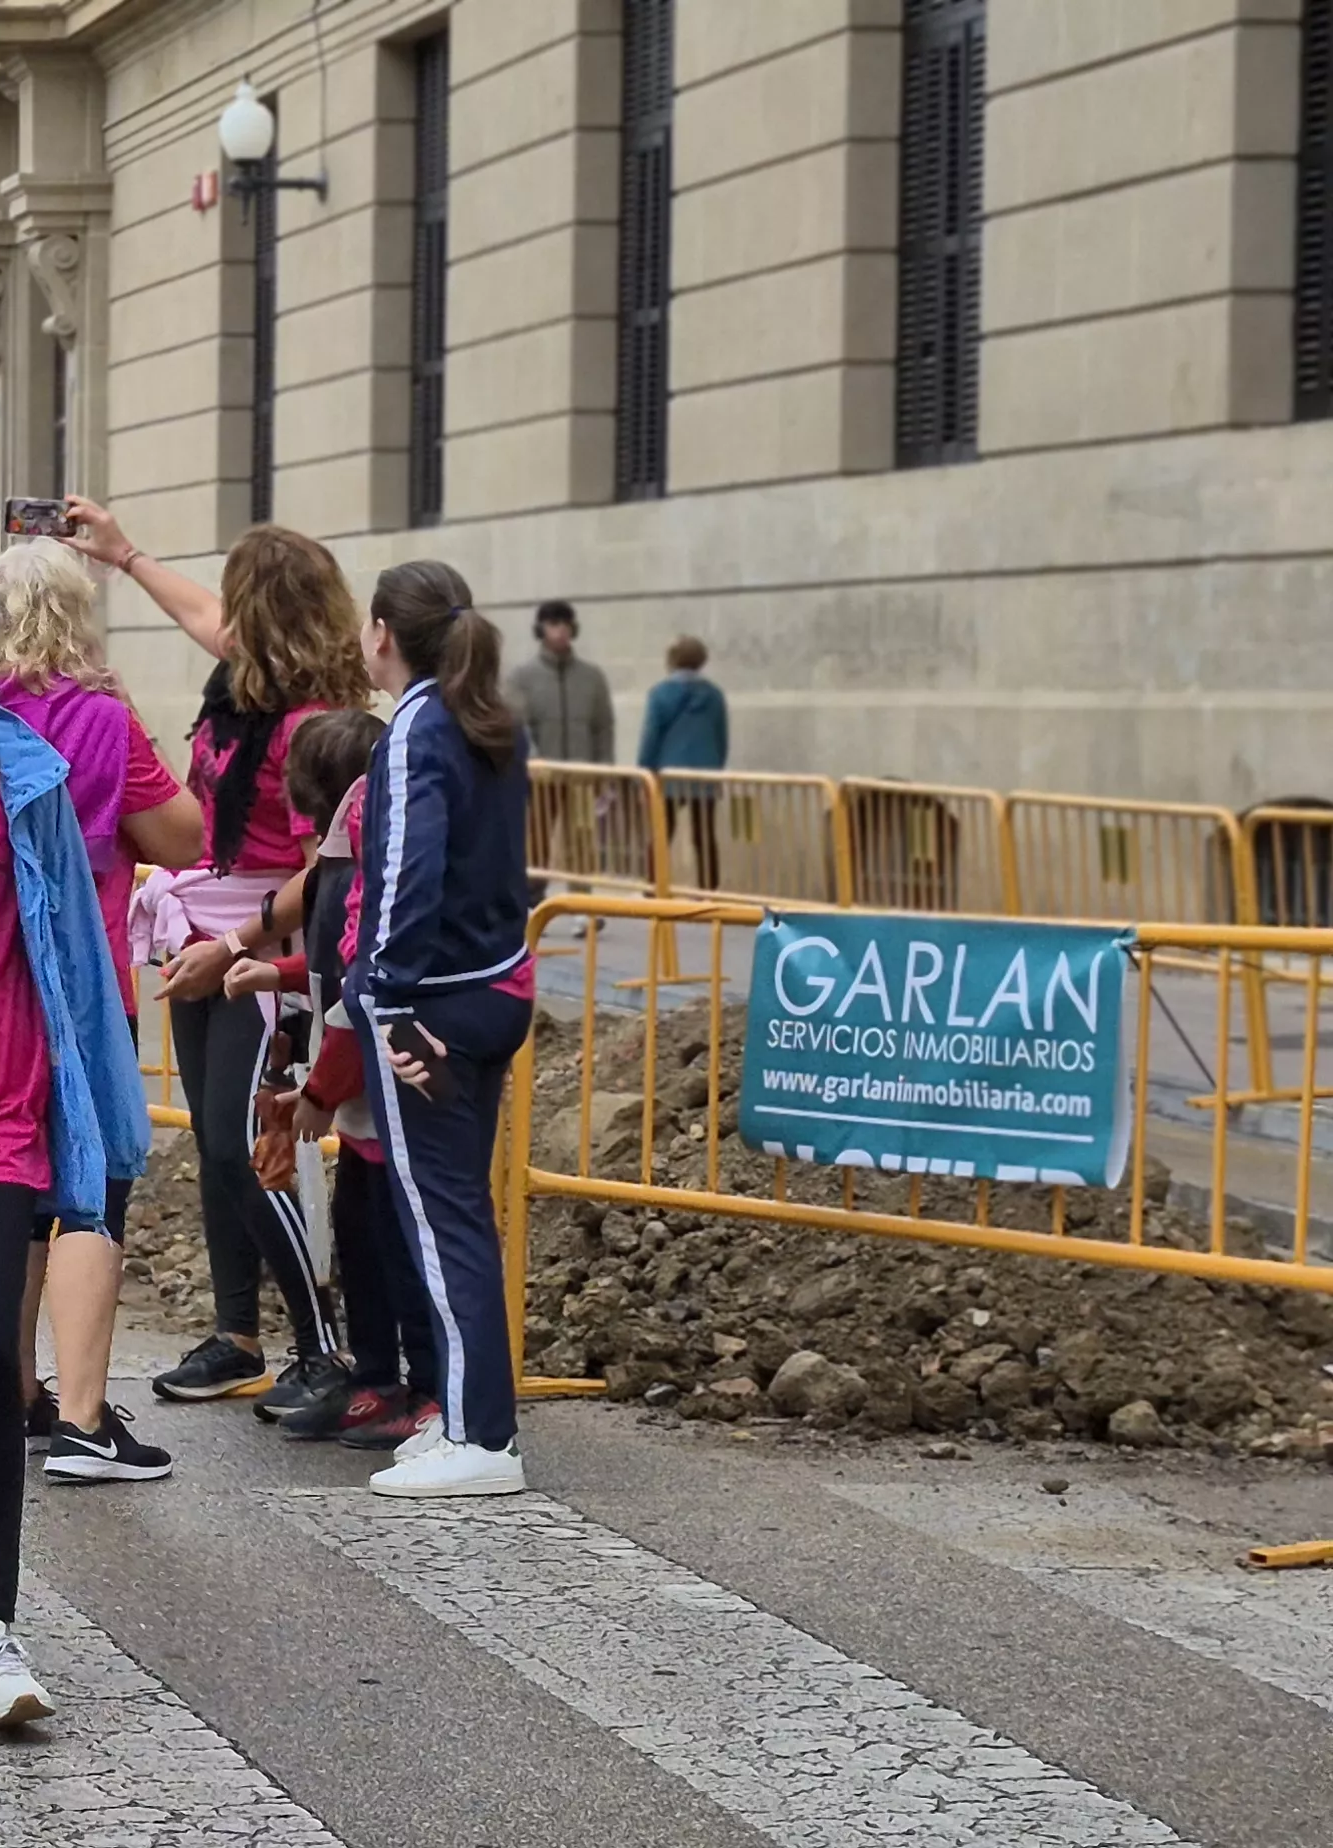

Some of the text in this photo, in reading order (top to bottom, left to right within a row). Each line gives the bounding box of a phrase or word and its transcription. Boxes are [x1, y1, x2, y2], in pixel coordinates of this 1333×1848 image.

[774, 936, 1103, 1034] GARLAN
[766, 1018, 1095, 1073] SERVICIOS INMOBILIARIOS
[763, 1068, 1092, 1118] www.garlaninmobiliaria.com
